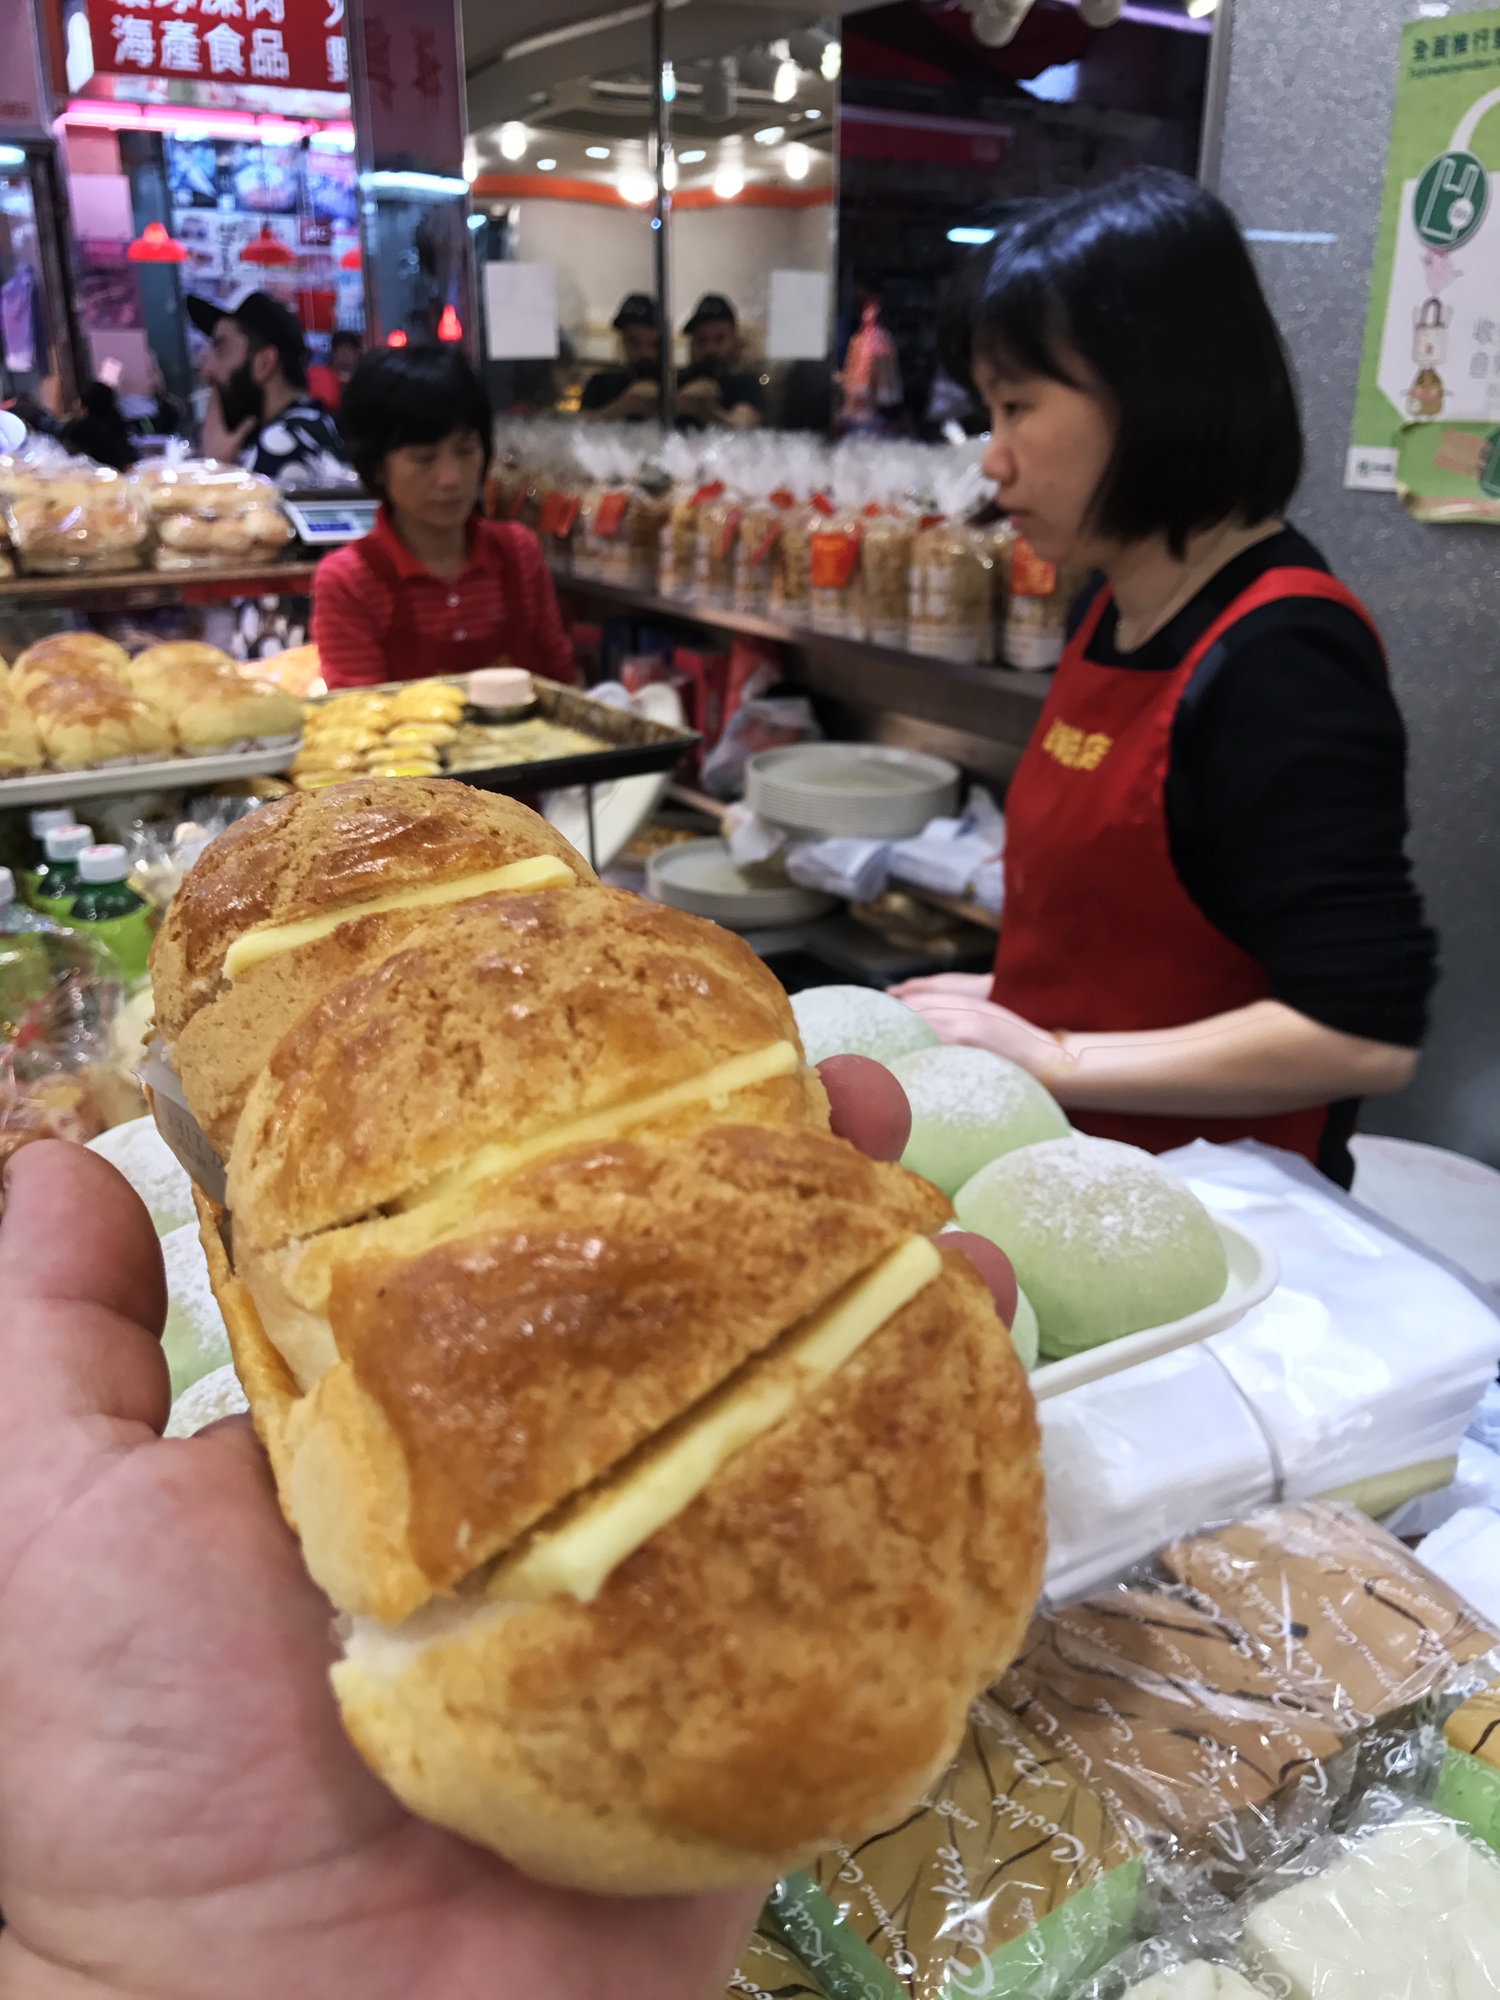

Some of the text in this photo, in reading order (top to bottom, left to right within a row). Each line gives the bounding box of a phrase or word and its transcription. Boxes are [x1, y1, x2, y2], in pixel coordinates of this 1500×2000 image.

[111, 14, 290, 81] 海產食品
[991, 1793, 1085, 1863] Cookie
[860, 1883, 918, 1976] Supreme
[930, 1845, 995, 1997] Cokie
